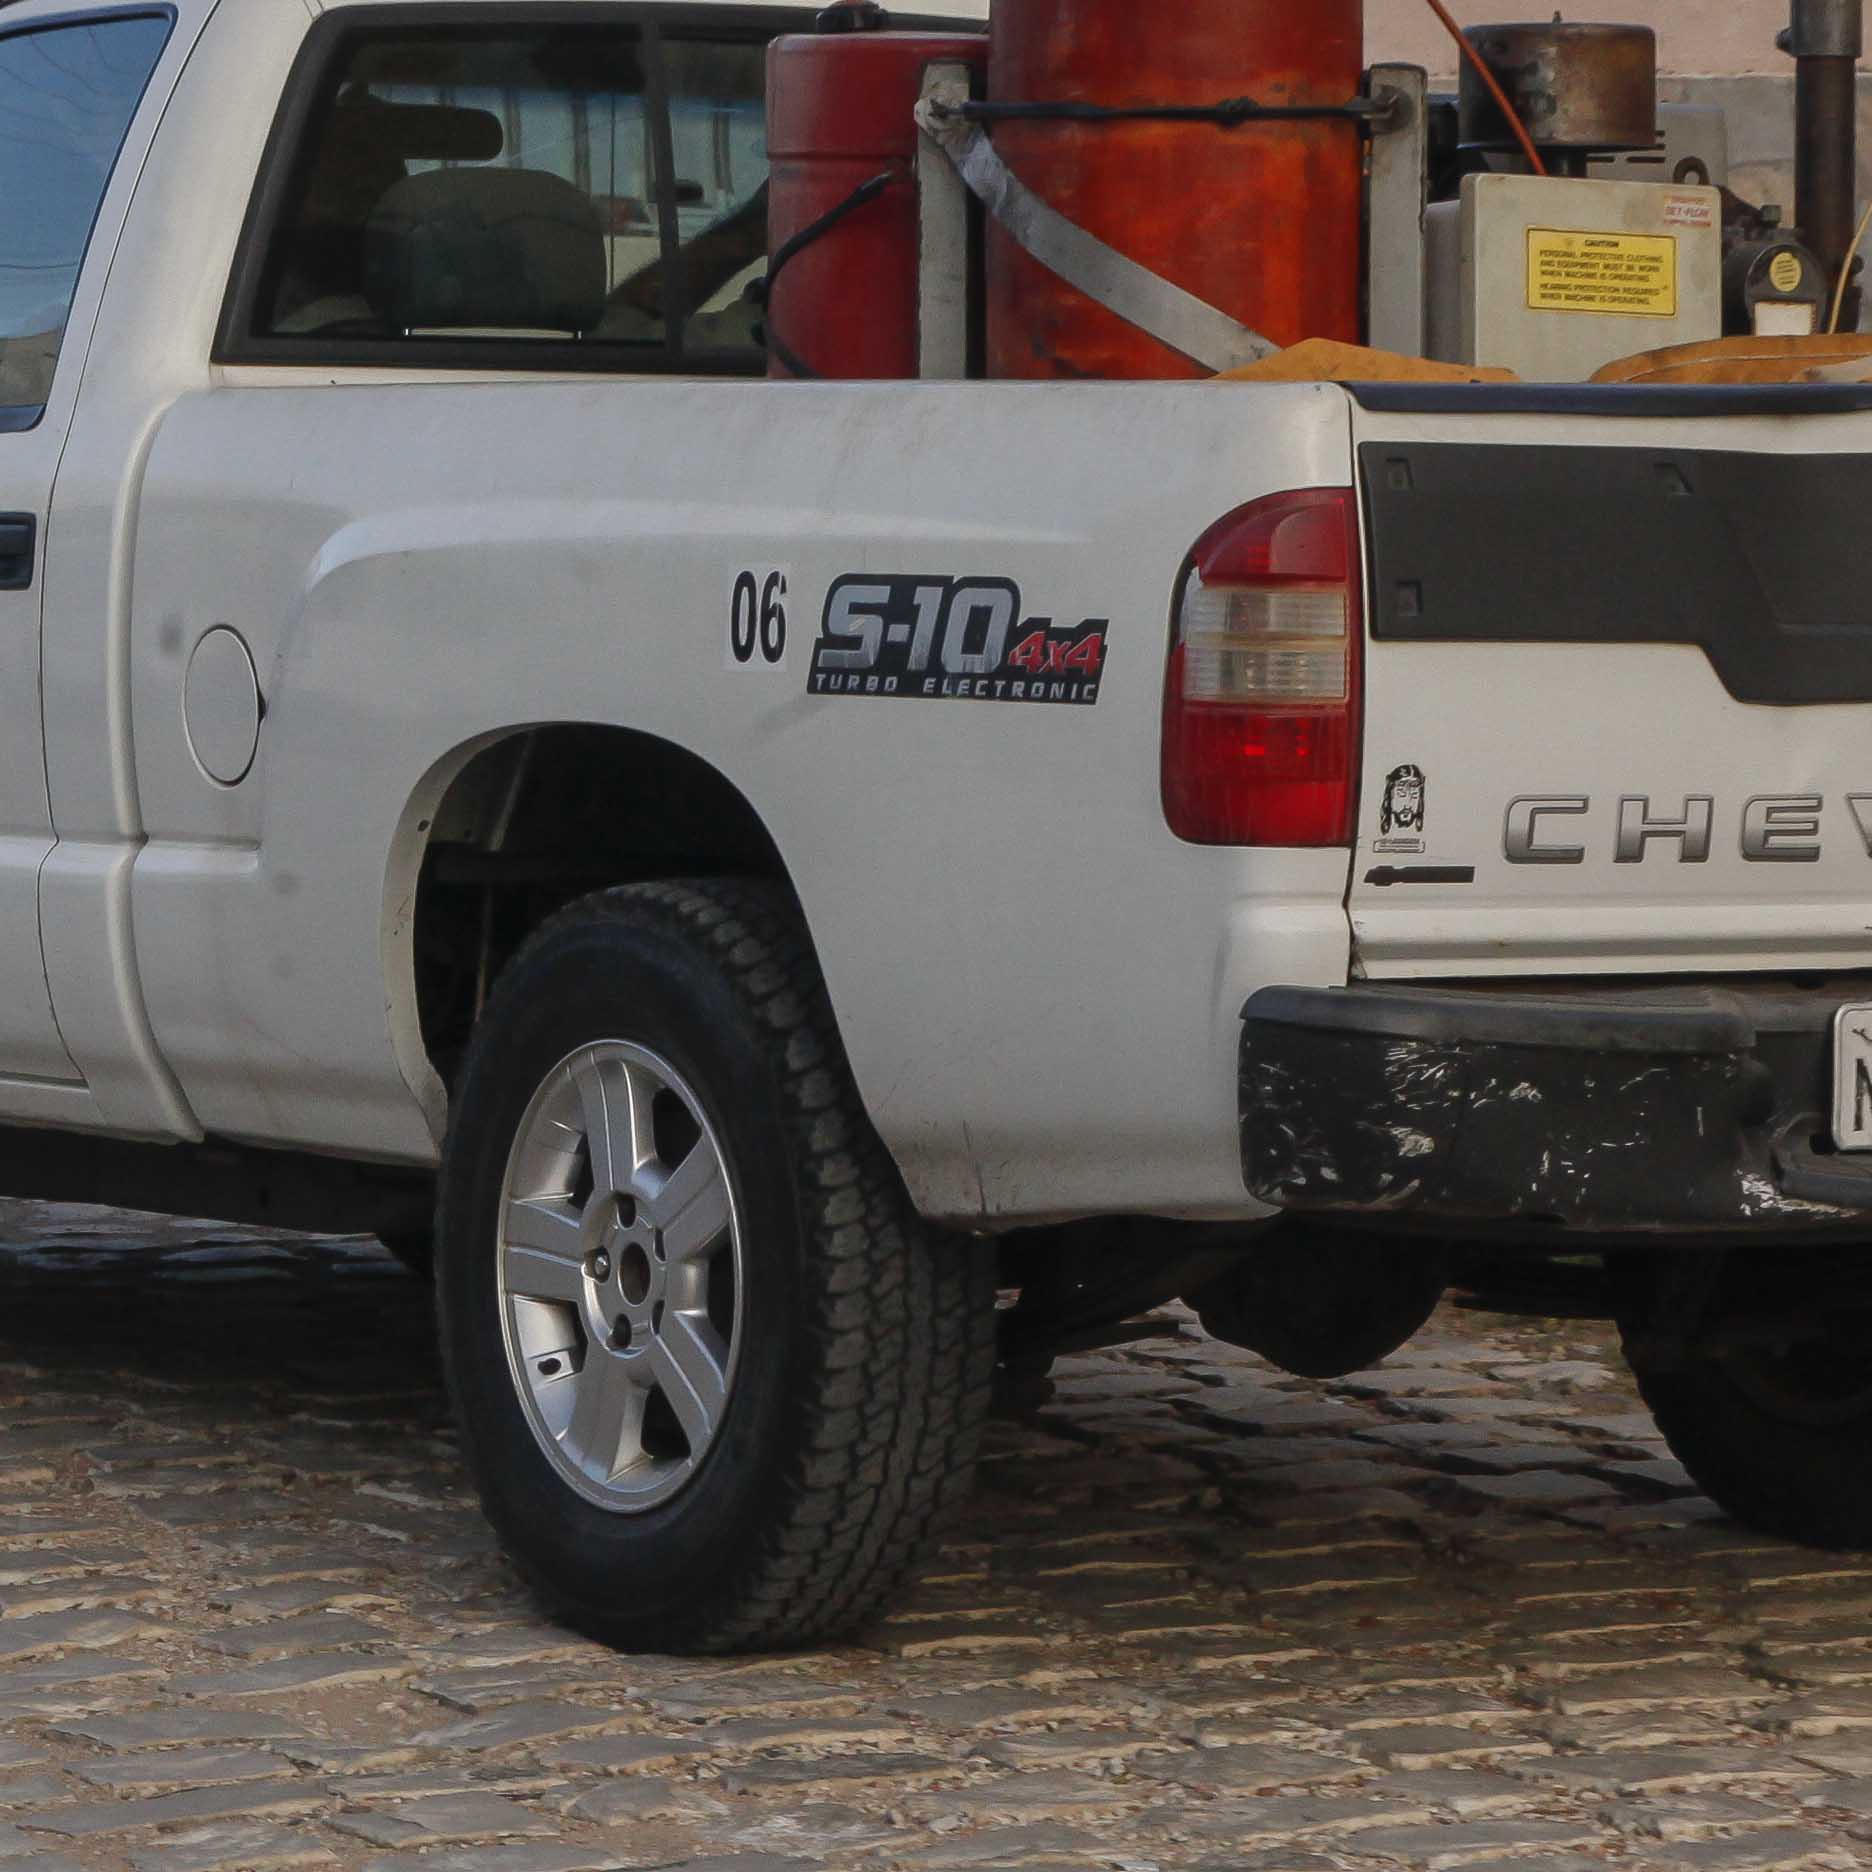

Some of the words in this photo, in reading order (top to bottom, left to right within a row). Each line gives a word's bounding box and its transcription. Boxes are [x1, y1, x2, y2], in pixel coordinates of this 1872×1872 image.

[1585, 239, 1619, 248] CAUTION
[730, 570, 787, 664] 06
[817, 584, 1013, 674] S-10
[1008, 629, 1104, 676] 4x4
[814, 673, 899, 692] TURBO
[922, 677, 1097, 701] ELECTRONIC
